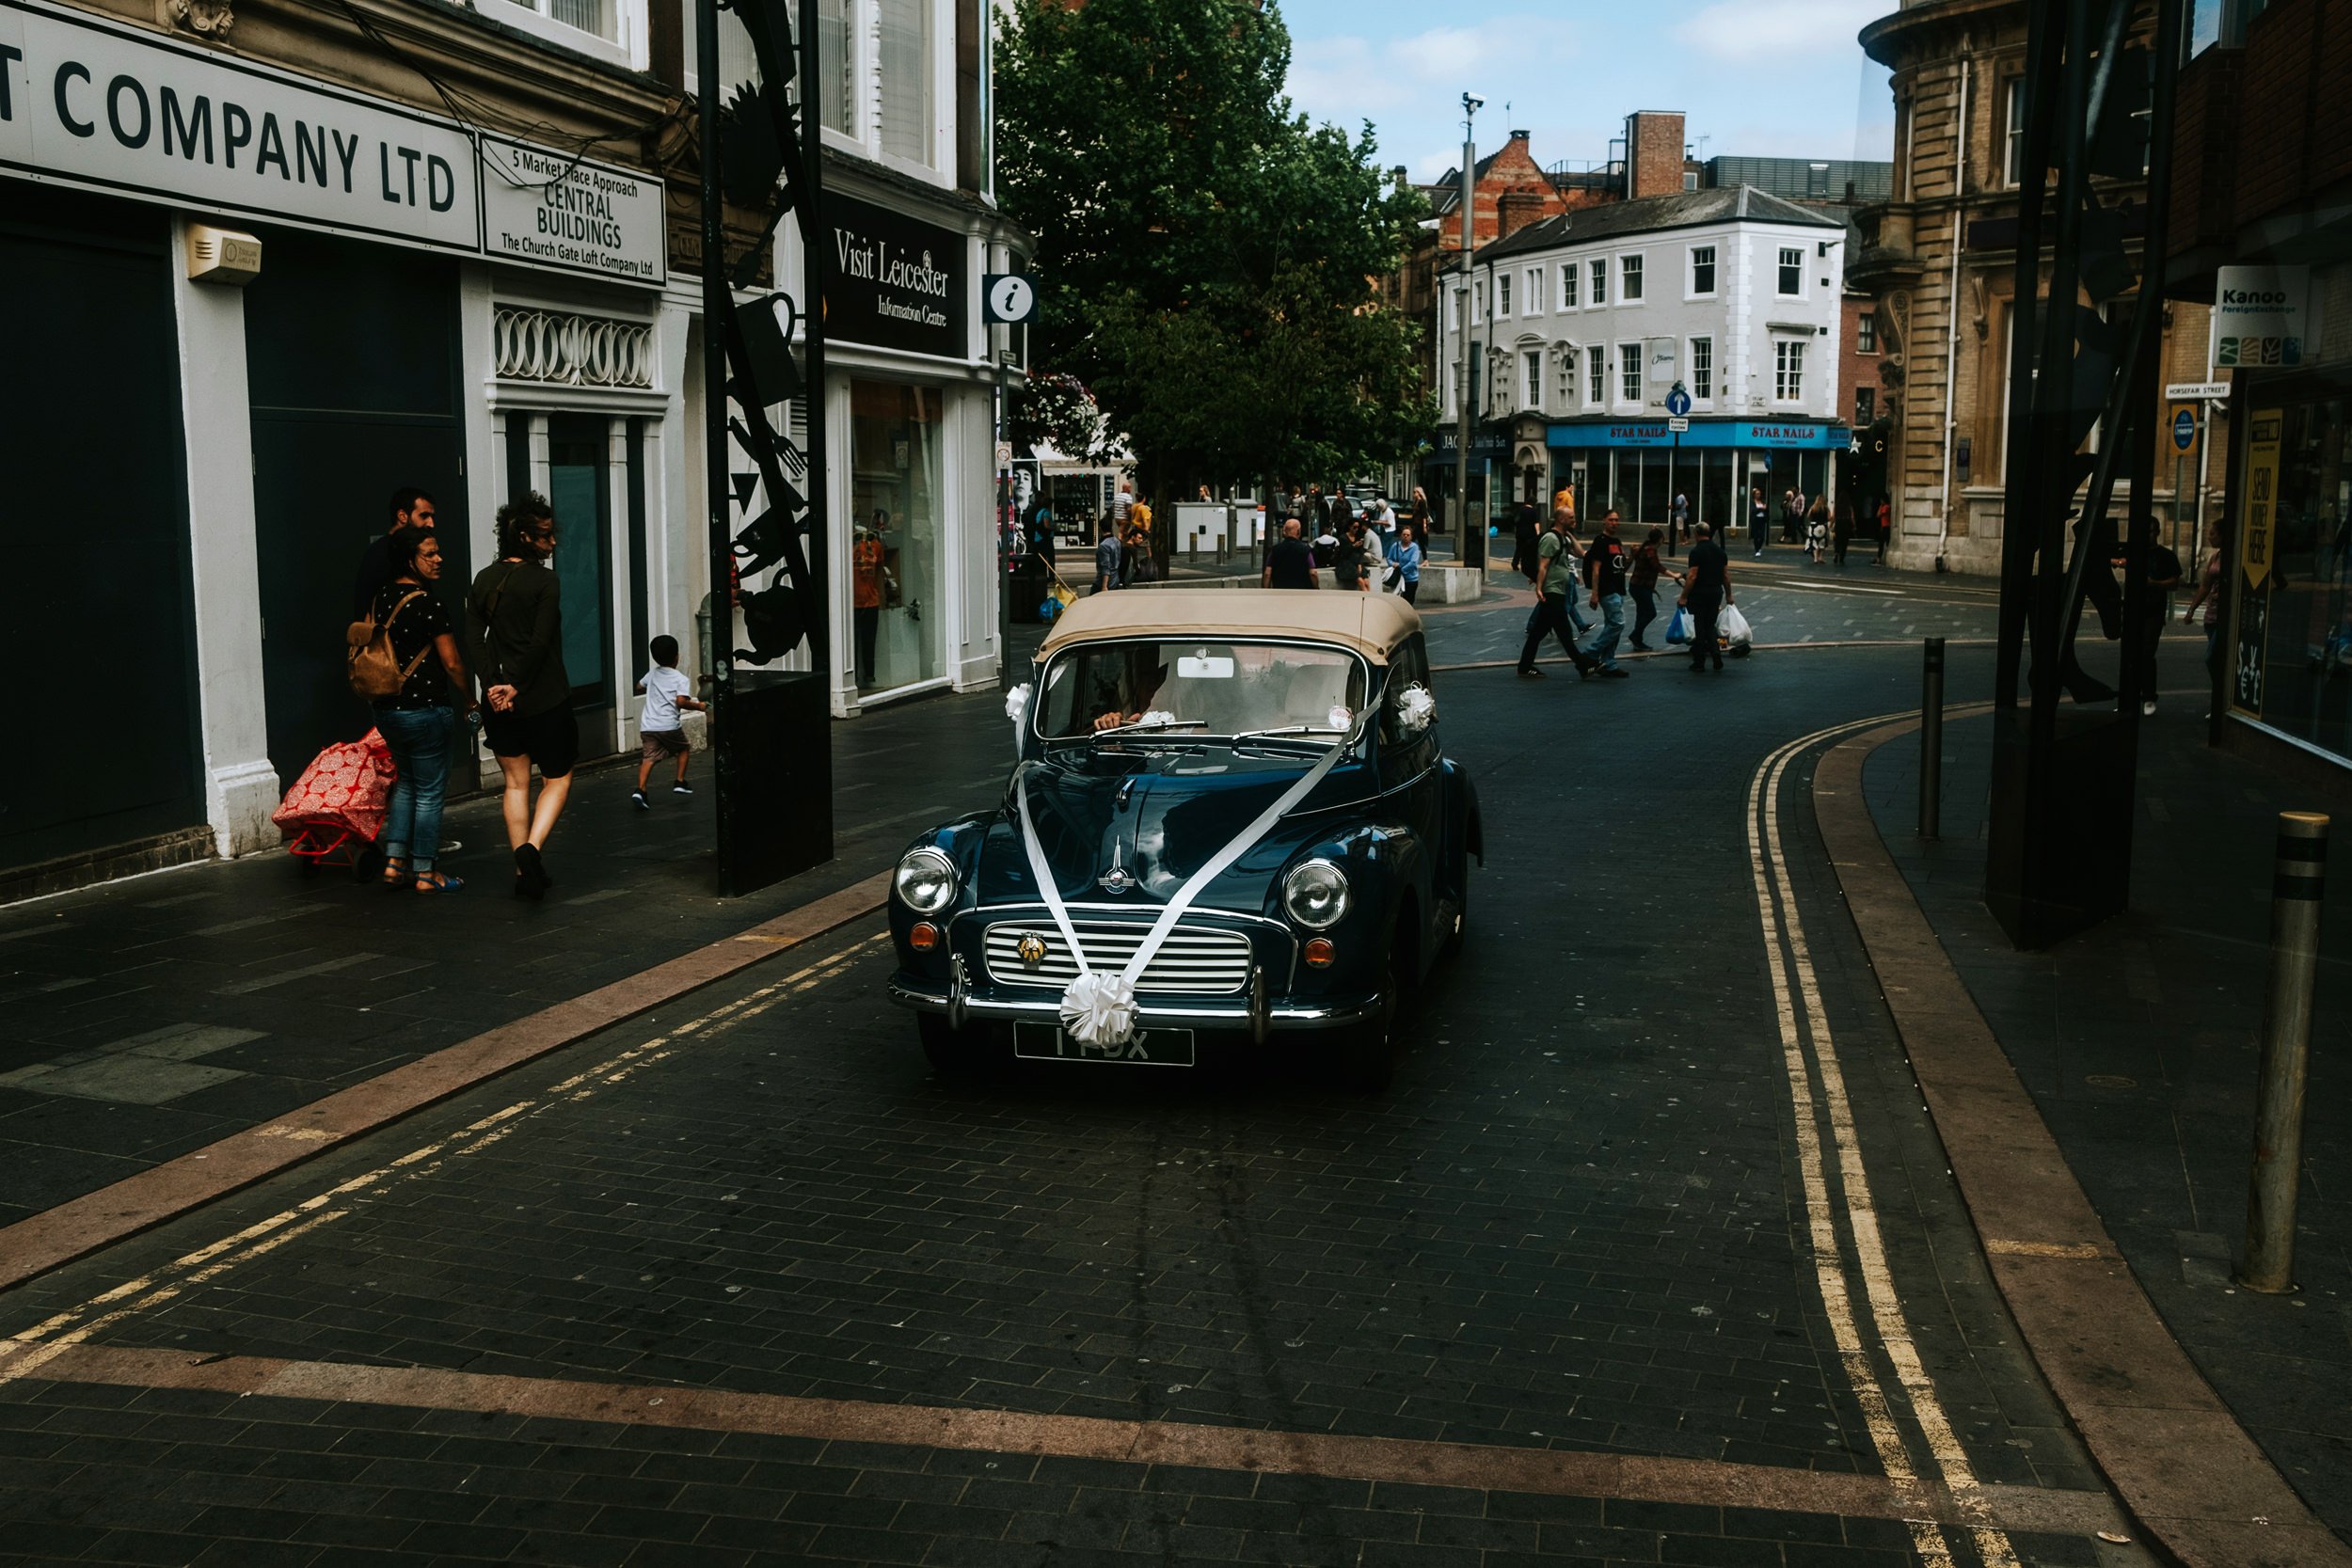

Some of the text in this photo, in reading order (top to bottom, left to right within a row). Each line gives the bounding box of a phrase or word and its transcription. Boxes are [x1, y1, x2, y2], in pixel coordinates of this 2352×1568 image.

[54, 61, 358, 193] COMPANY
[380, 141, 454, 213] LTD
[513, 150, 638, 198] 5 Market Place Approach
[544, 182, 614, 221] CENTRAL
[537, 207, 622, 249] BUILDINGS
[501, 232, 653, 277] The Church Gate Loft Company Ltd
[834, 228, 948, 297] Visit Leicester
[878, 294, 946, 327] Information Centre
[2223, 290, 2286, 304] Kanoo
[1610, 427, 1666, 437] STAR NAILS
[1752, 426, 1815, 438] STAR NAILS
[2252, 467, 2272, 501] SEND
[2248, 528, 2266, 565] HERE
